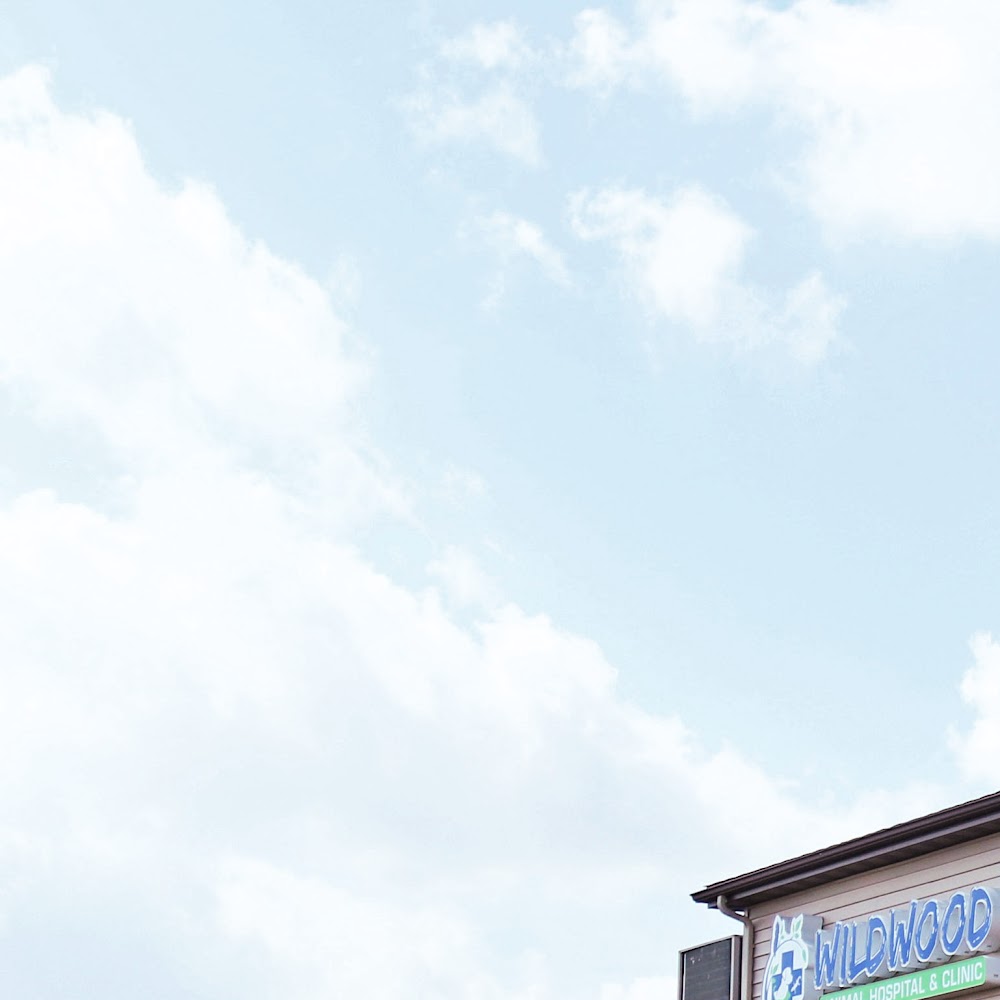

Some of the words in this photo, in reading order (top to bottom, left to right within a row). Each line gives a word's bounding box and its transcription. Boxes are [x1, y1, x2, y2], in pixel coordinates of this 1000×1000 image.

[814, 886, 991, 990] WILDWOOD
[929, 973, 938, 989] &
[942, 963, 983, 988] CLINIC
